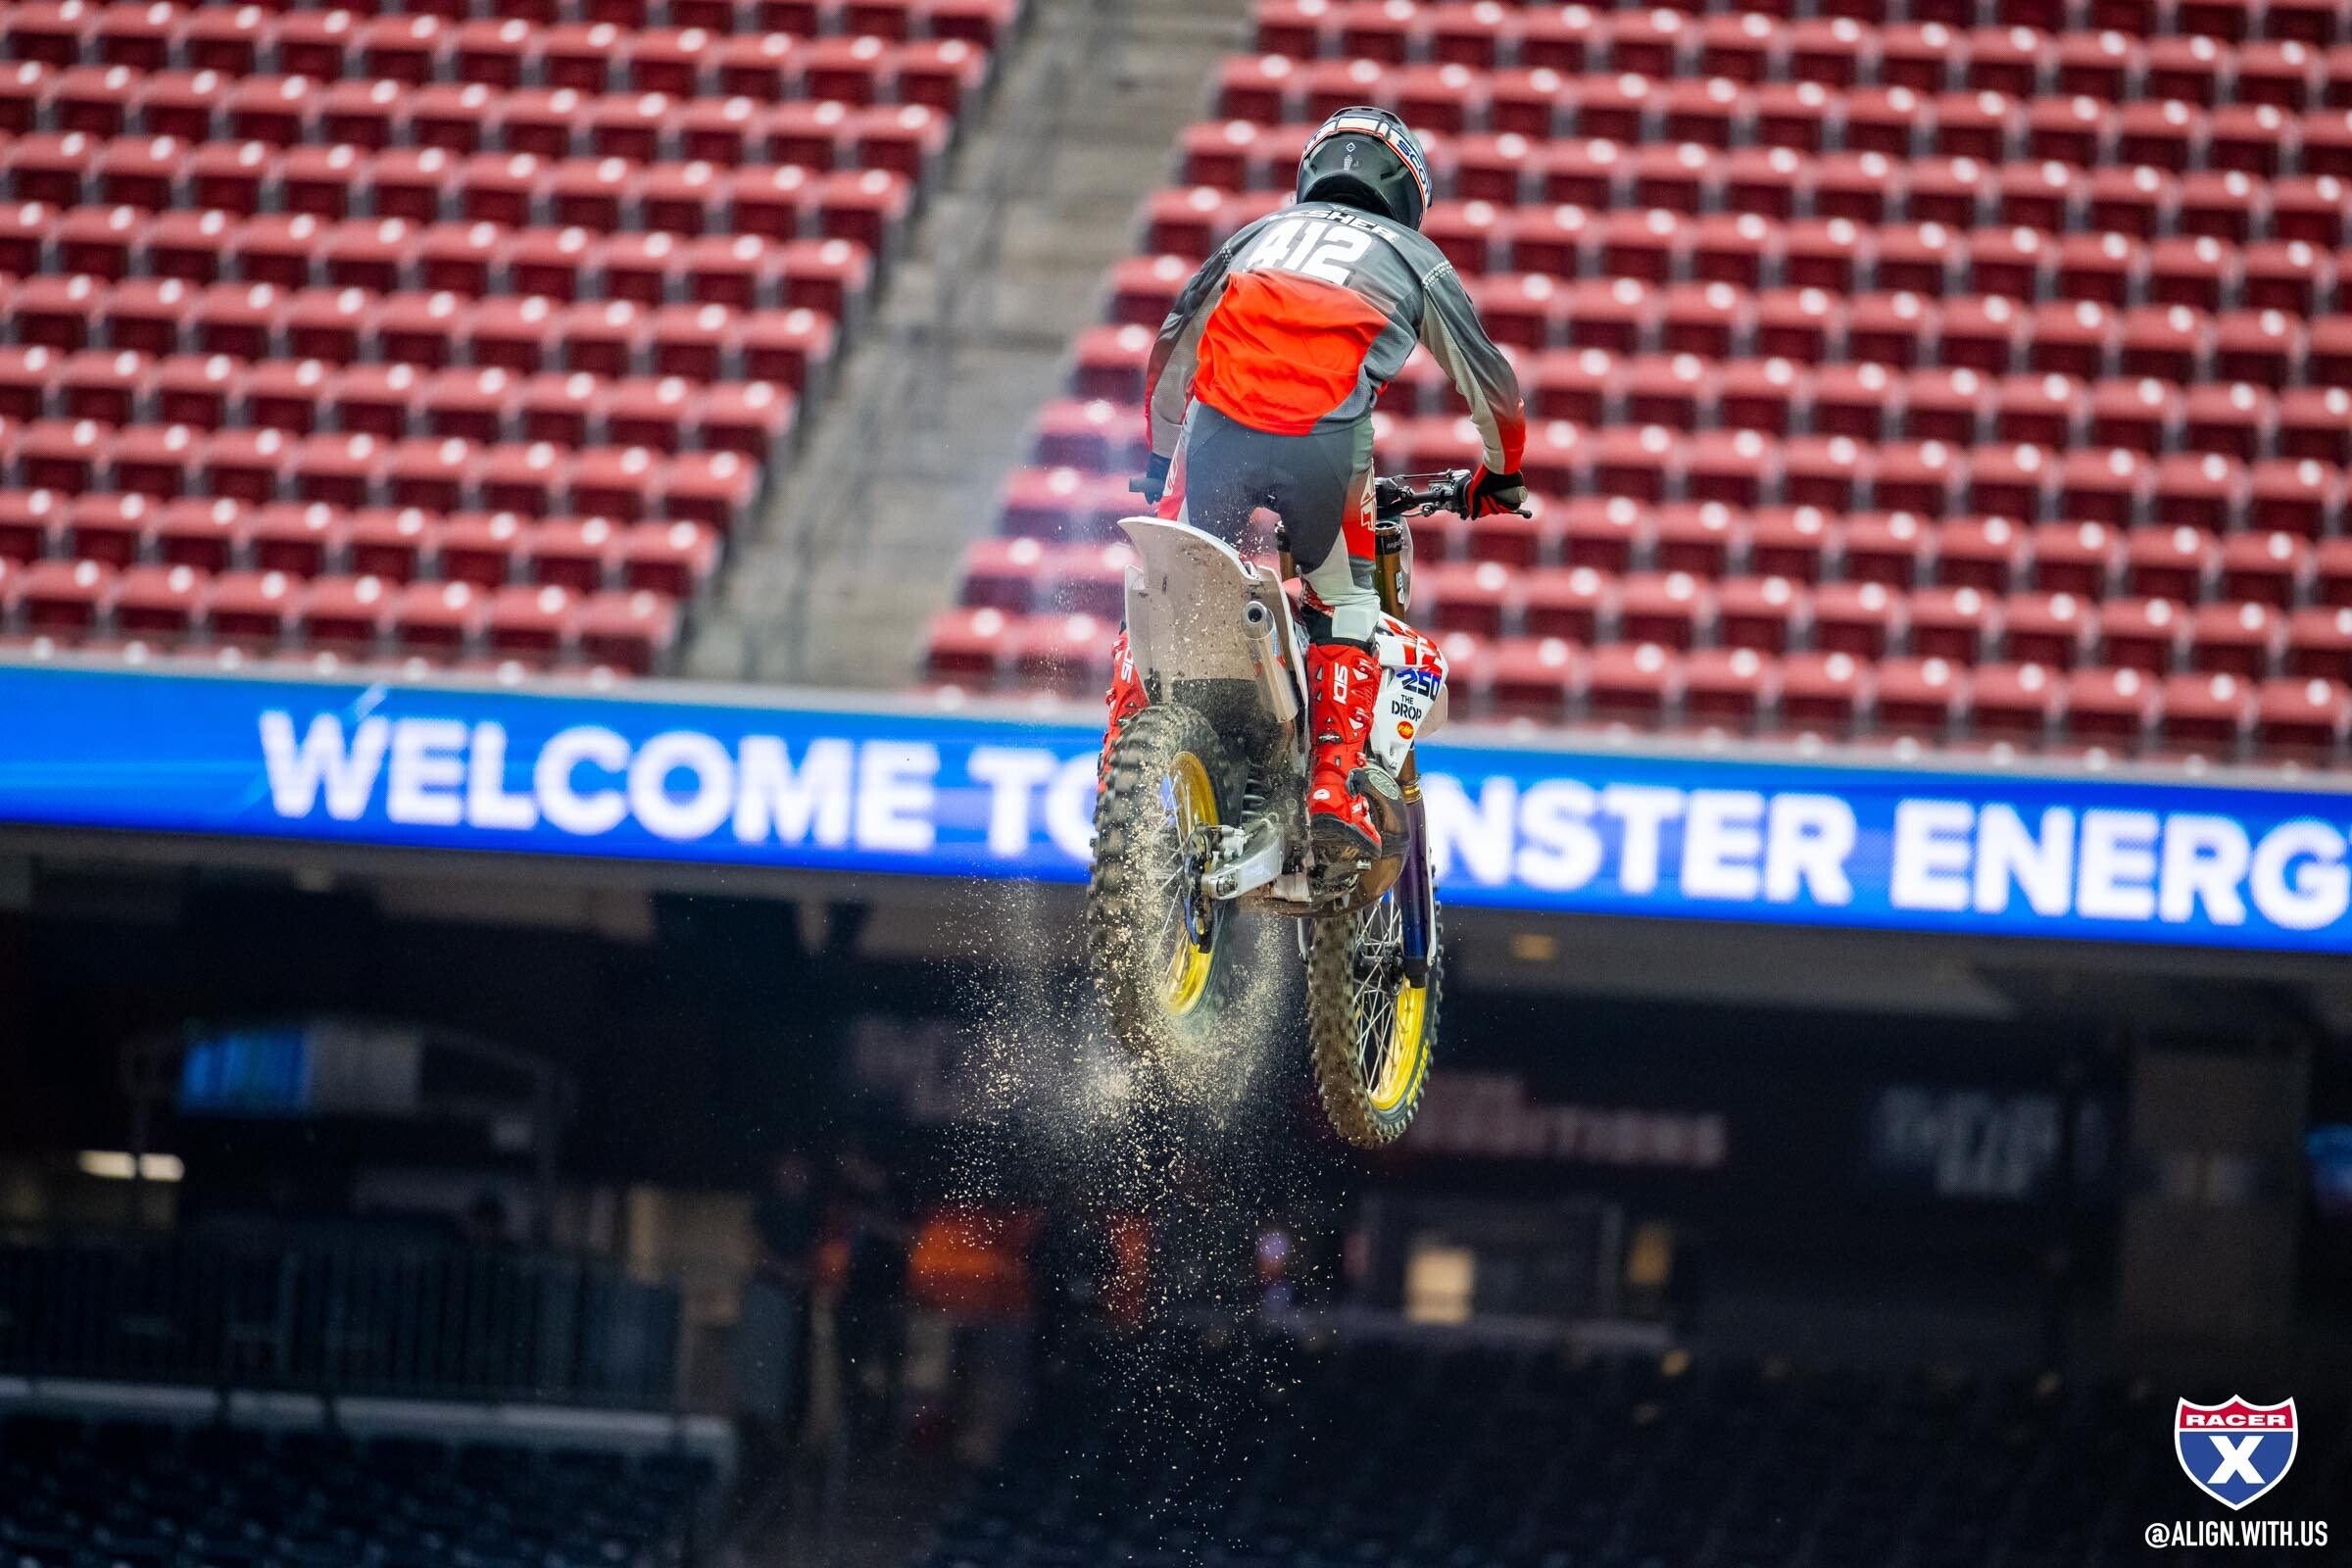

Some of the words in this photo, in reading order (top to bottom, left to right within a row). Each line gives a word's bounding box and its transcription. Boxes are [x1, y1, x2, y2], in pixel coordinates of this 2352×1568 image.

[1245, 219, 1373, 286] 412
[1391, 700, 1422, 722] DROP
[1400, 694, 1414, 706] THE
[258, 710, 941, 855] WELCOME
[1421, 771, 1858, 907] NSTER
[1889, 798, 2352, 931] ENERG
